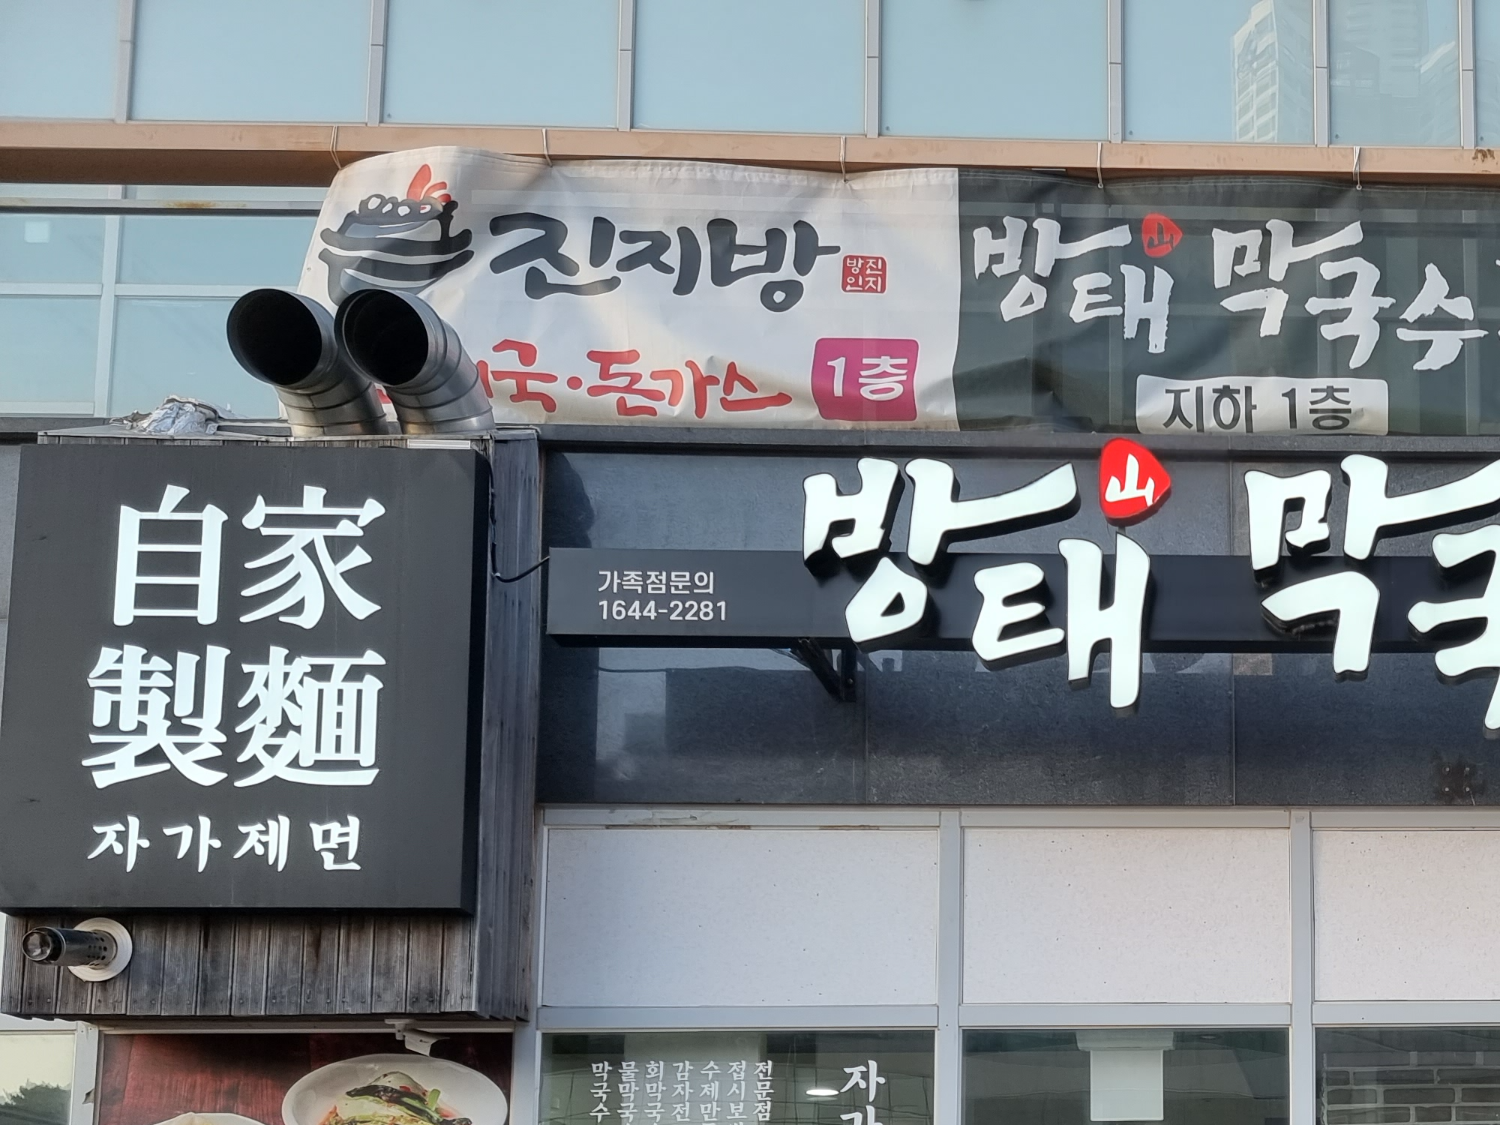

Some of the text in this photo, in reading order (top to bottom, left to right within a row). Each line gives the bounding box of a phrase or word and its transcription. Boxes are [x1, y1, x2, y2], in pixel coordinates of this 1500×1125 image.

[489, 212, 841, 312] 진지방
[973, 215, 1488, 369] 방태 막국수
[478, 339, 792, 419] 국·돈가스
[825, 355, 910, 401] 1층
[1163, 385, 1353, 433] 지하 1층
[112, 484, 386, 629] 自家
[598, 570, 715, 595] 가족점문의
[803, 457, 1150, 708] 방태
[598, 600, 728, 622] 1644-2281
[81, 644, 387, 789] 製麵
[87, 814, 362, 872] 자가제면
[589, 1061, 613, 1123] 막국수
[671, 1060, 694, 1122] 감자전
[752, 1060, 775, 1121] 전문점
